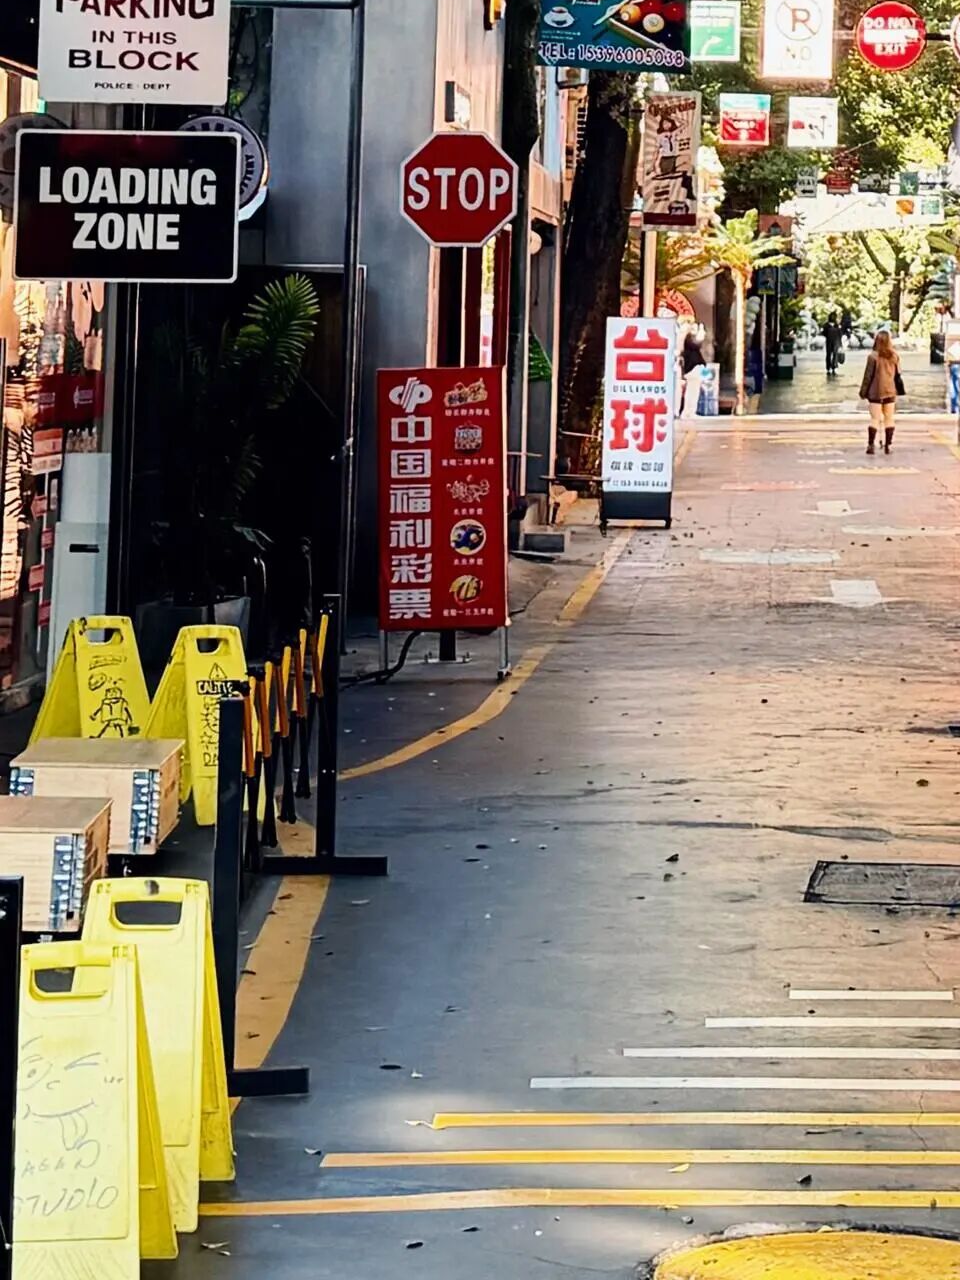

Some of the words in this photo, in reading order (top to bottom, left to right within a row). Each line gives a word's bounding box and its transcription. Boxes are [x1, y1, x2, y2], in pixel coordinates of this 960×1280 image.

[864, 16, 885, 30] DO
[92, 30, 114, 43] IN
[123, 31, 177, 45] THIS
[68, 49, 200, 71] BLOCK
[874, 42, 906, 56] EXIT
[94, 82, 134, 90] POLICE
[39, 166, 217, 205] LOADING
[407, 166, 510, 211] STOP
[72, 212, 180, 250] ZONE
[389, 414, 432, 619] 中国福利彩票
